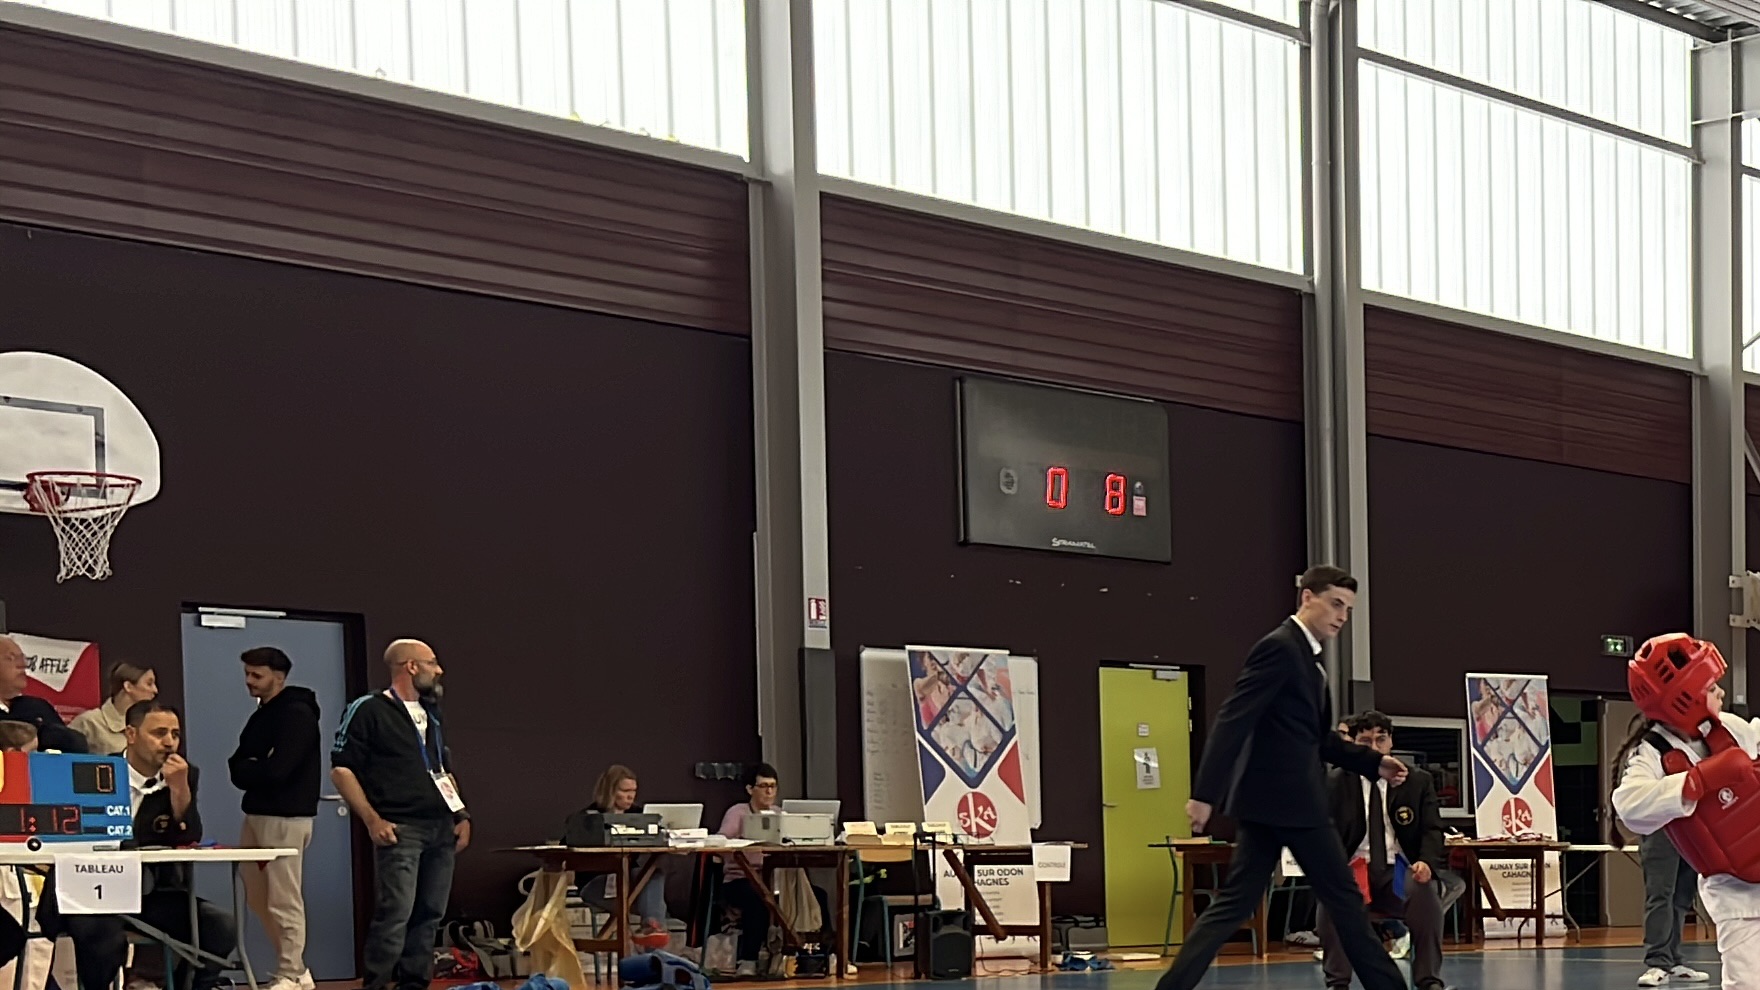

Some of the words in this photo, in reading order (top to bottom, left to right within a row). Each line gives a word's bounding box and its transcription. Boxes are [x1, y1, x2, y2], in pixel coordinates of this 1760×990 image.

[1046, 467, 1068, 509] 0
[1105, 473, 1127, 516] 8
[106, 805, 131, 817] CAT.1
[106, 825, 133, 836] CAT.2
[74, 864, 124, 874] TABLEAU
[977, 868, 995, 878] SUR
[996, 868, 1025, 877] ODON
[94, 884, 102, 900] 1
